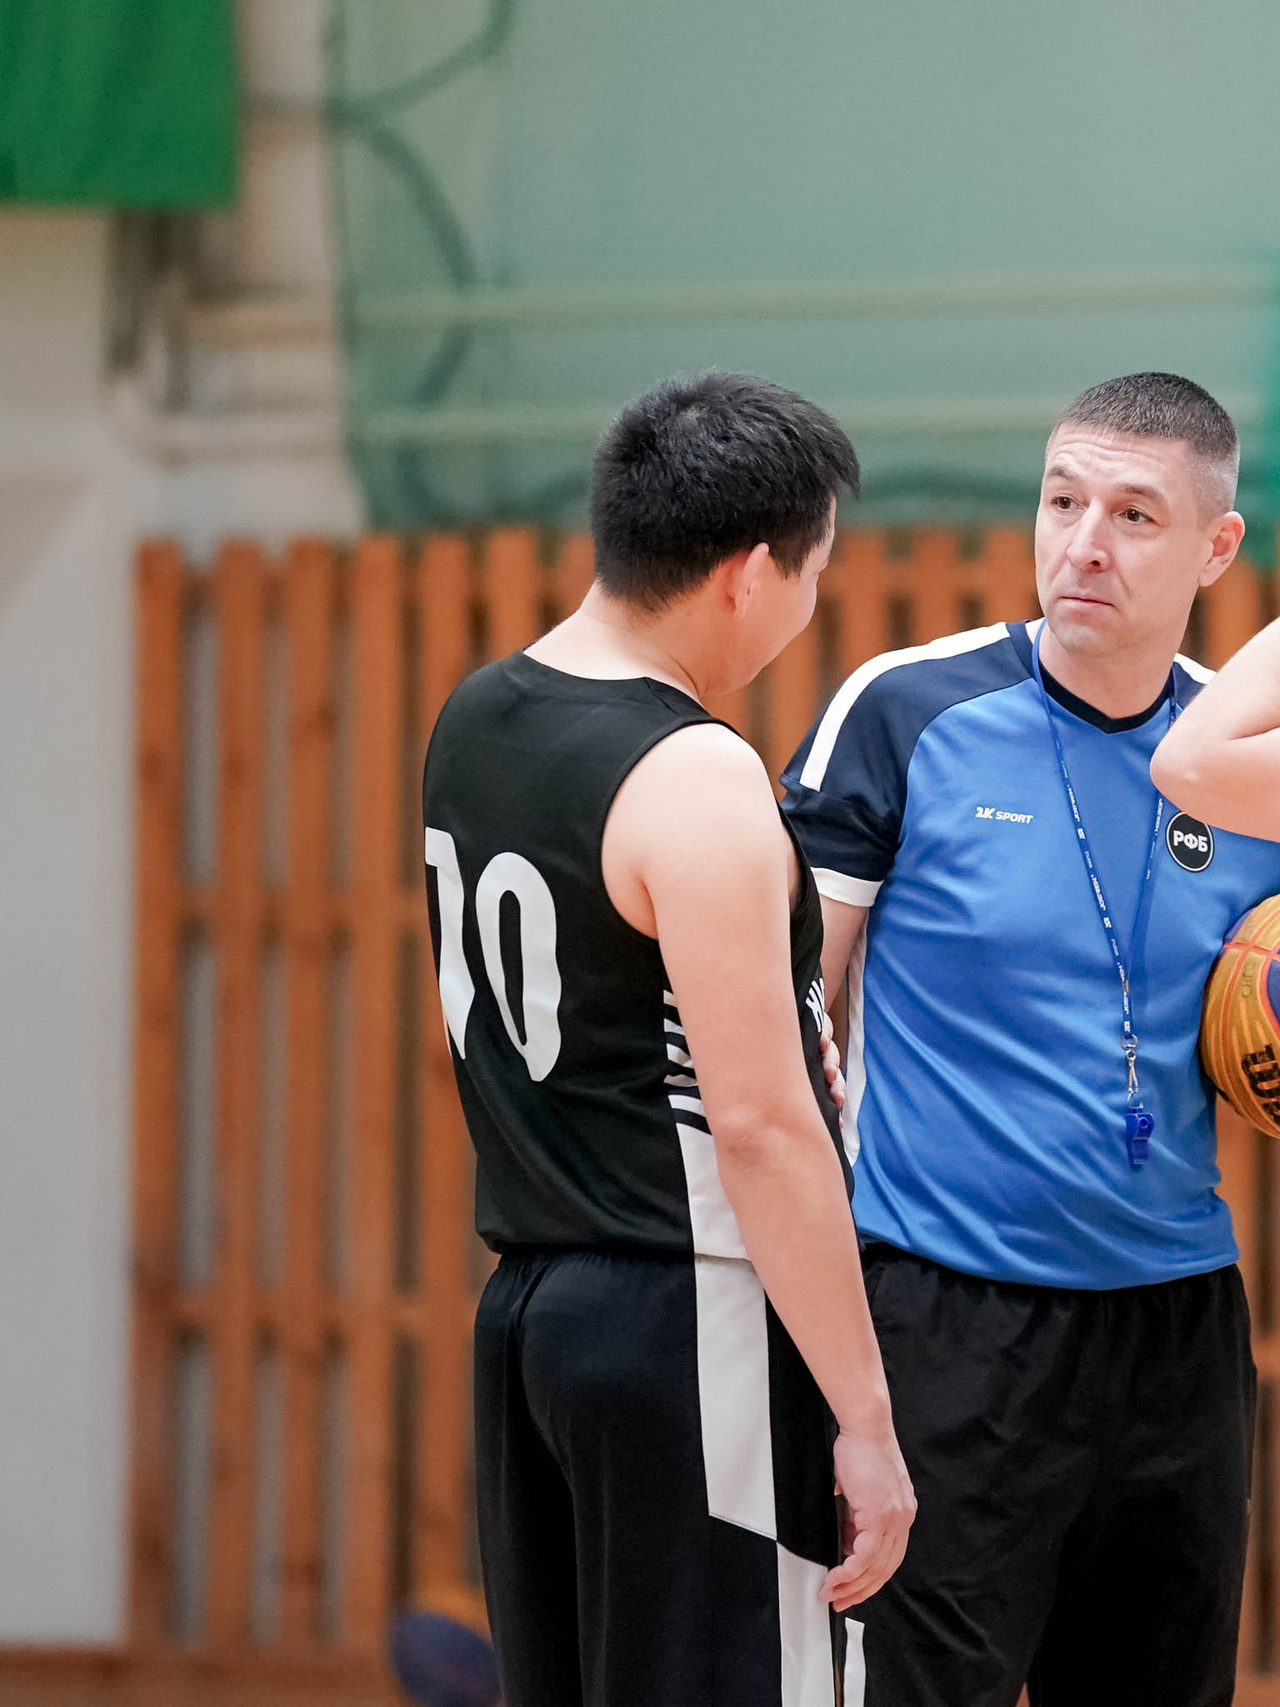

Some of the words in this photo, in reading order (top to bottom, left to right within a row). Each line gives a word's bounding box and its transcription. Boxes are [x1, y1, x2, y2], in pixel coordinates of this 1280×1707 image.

[975, 806, 996, 819] 2K
[995, 810, 1034, 824] SPORT
[1173, 830, 1209, 852] РФБ
